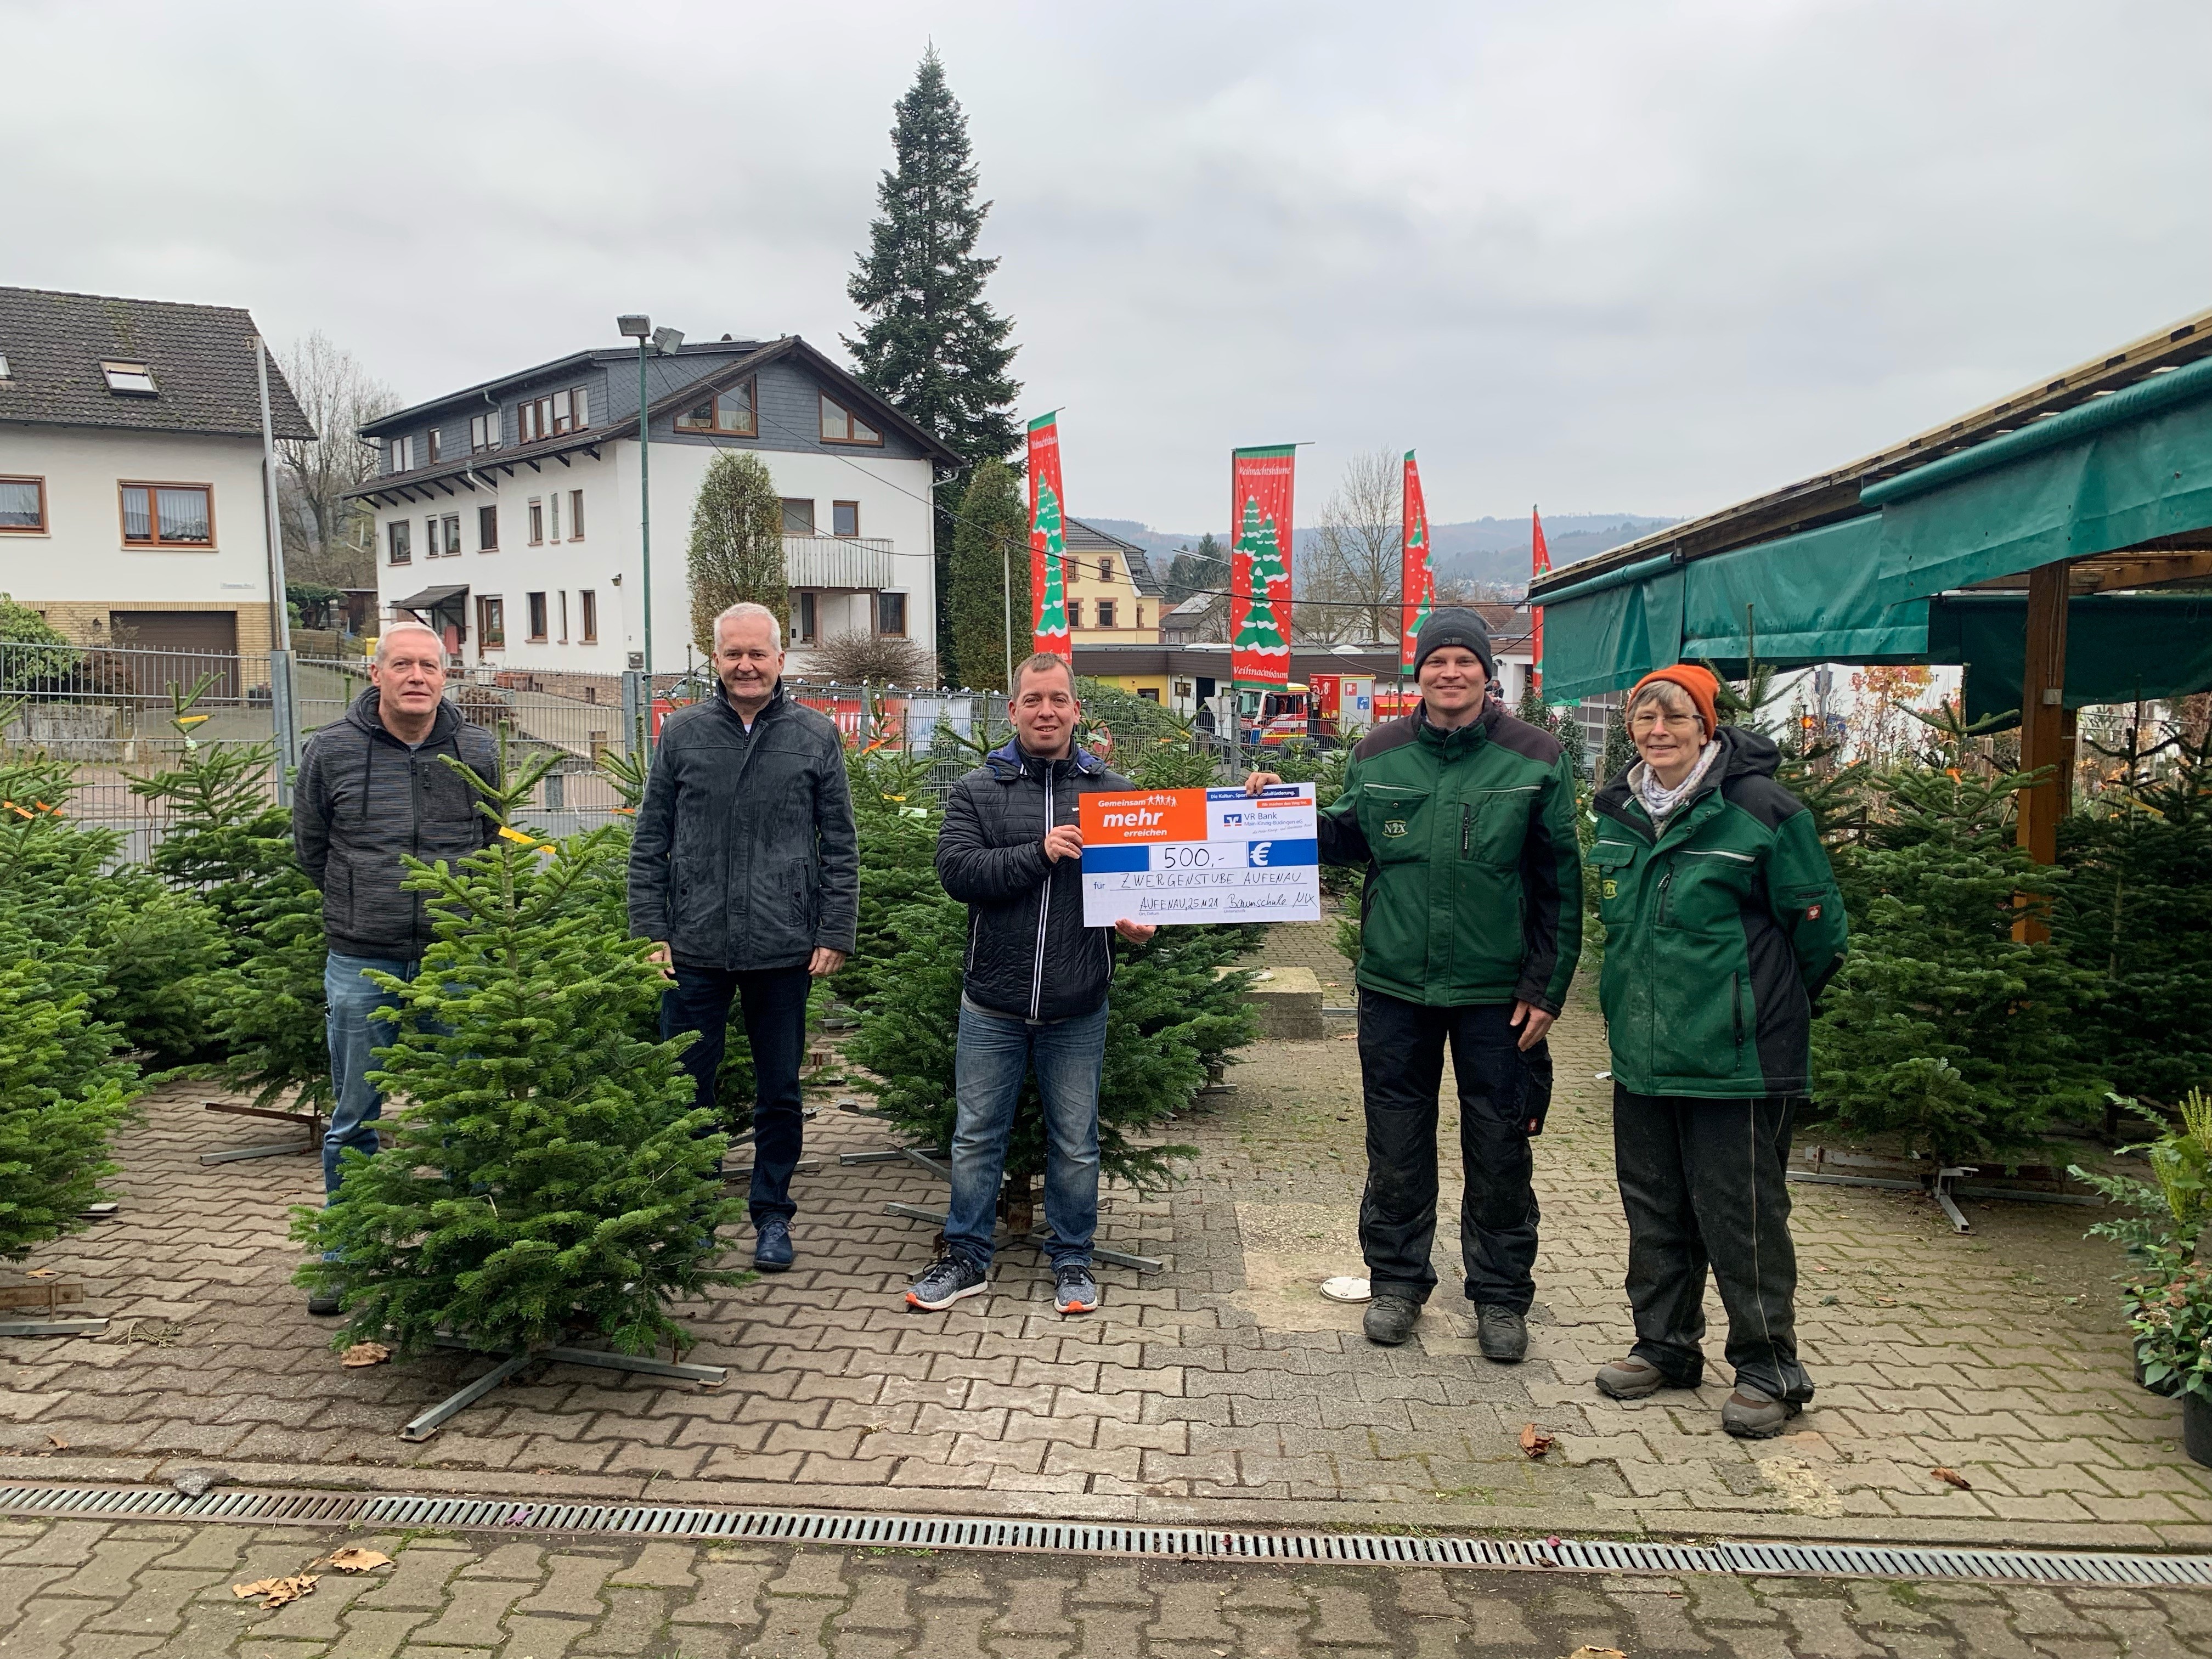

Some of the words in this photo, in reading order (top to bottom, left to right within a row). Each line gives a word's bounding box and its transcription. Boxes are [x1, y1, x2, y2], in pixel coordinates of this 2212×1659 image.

[1103, 808, 1164, 827] mehr
[1124, 828, 1167, 837] erreichen
[1165, 848, 1224, 868] 500,-
[1250, 842, 1272, 866] €
[1120, 873, 1234, 888] ZWERGENSTUBE
[1244, 872, 1301, 885] AUFENAU
[1228, 893, 1287, 909] Baumschule
